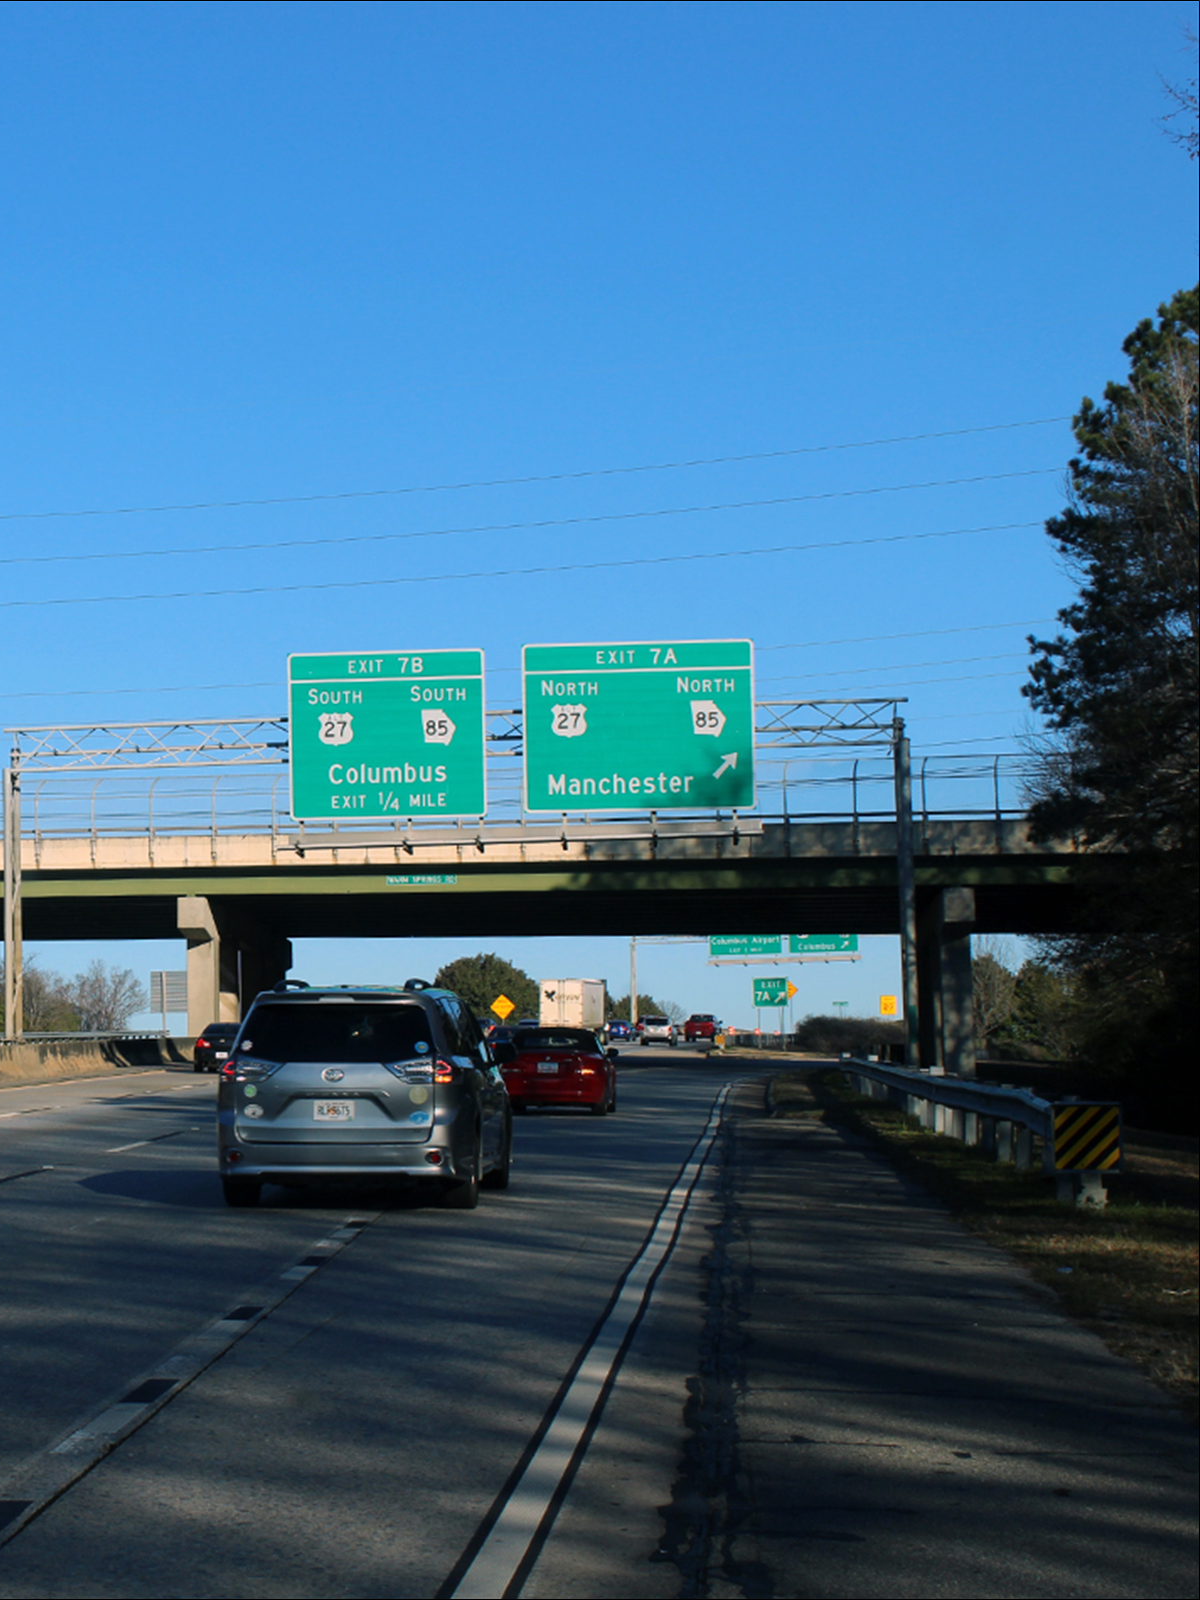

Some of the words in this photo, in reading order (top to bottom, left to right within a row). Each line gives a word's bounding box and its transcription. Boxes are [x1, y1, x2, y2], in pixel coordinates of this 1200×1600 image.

[595, 650, 636, 665] EXIT
[649, 648, 678, 665] 7A
[347, 659, 384, 675] EXIT
[397, 657, 425, 674] 7B
[540, 680, 599, 697] NORTH
[676, 676, 736, 693] NORTH
[307, 688, 364, 705] SOUTH
[409, 685, 467, 702] SOUTH
[425, 720, 449, 737] 85
[557, 712, 582, 730] 27
[694, 711, 720, 729] 85
[323, 721, 348, 738] 27
[328, 762, 448, 785] Columbus
[547, 772, 695, 796] Manchester
[330, 794, 367, 809] EXIT
[408, 792, 448, 808] MILE
[710, 937, 748, 946] Columbus
[752, 936, 780, 945] Airport
[798, 942, 836, 950] Columbus
[761, 980, 781, 989] EXIT
[755, 990, 771, 1002] 7A
